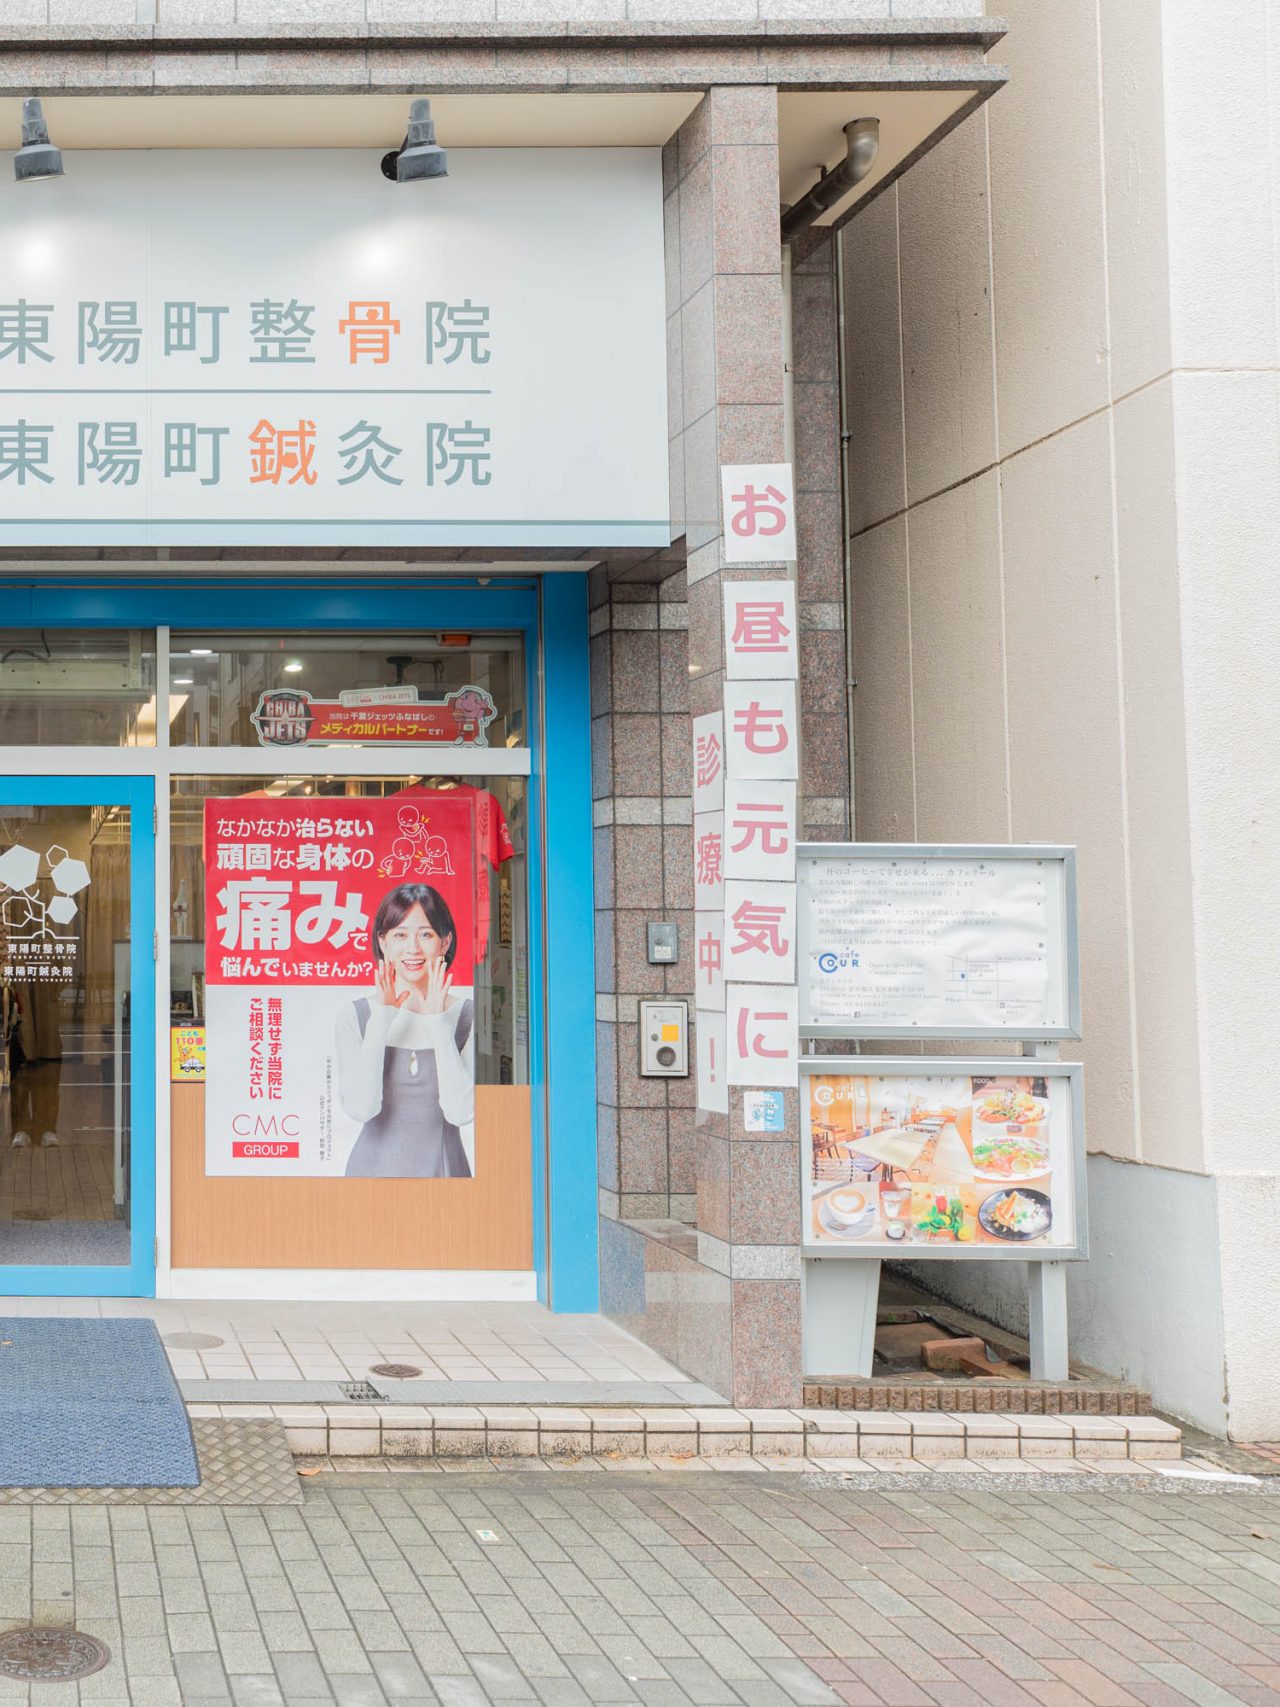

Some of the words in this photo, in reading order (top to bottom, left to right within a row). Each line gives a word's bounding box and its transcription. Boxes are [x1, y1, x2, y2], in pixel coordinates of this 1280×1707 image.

[263, 719, 308, 739] JETS
[730, 485, 789, 1058] お昼も元気に
[217, 818, 374, 838] なかなか治らない
[217, 843, 374, 870] 頑固な身体の
[216, 876, 369, 951] 痛みで
[696, 733, 722, 1083] 診療中!
[7, 943, 77, 954] 東陽町整骨院
[840, 950, 859, 958] cafe
[3, 966, 73, 977] 東陽町鍼灸院
[222, 956, 373, 978] 悩んでいませんか?
[249, 997, 264, 1099] ご相談ください
[267, 997, 282, 1100] 無理せず当院に
[232, 1113, 300, 1136] CMC
[243, 1144, 288, 1156] GROUP
